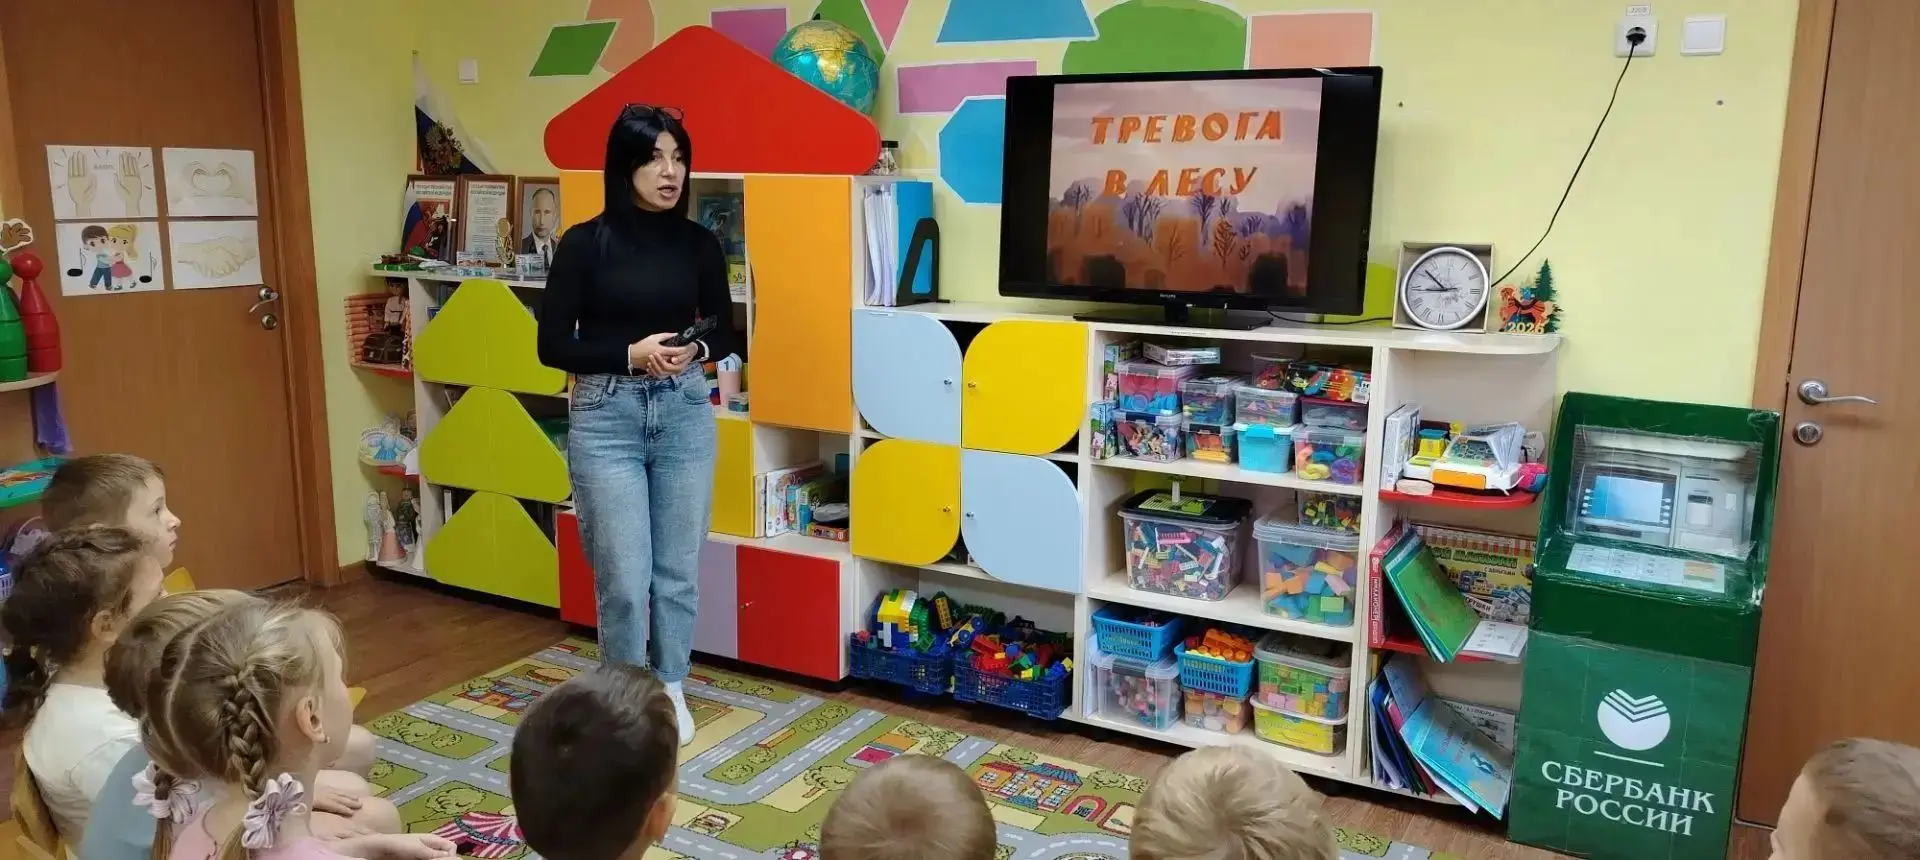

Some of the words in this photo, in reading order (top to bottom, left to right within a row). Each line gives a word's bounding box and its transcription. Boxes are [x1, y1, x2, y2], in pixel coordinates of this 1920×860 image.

[1091, 110, 1281, 144] ТРЕВОГА
[1103, 169, 1128, 197] В
[1144, 166, 1258, 197] ЛЕСУ
[1507, 321, 1545, 334] 2026
[1541, 760, 1715, 814] СБЕРБАНК
[1555, 788, 1695, 836] РОССИИ
